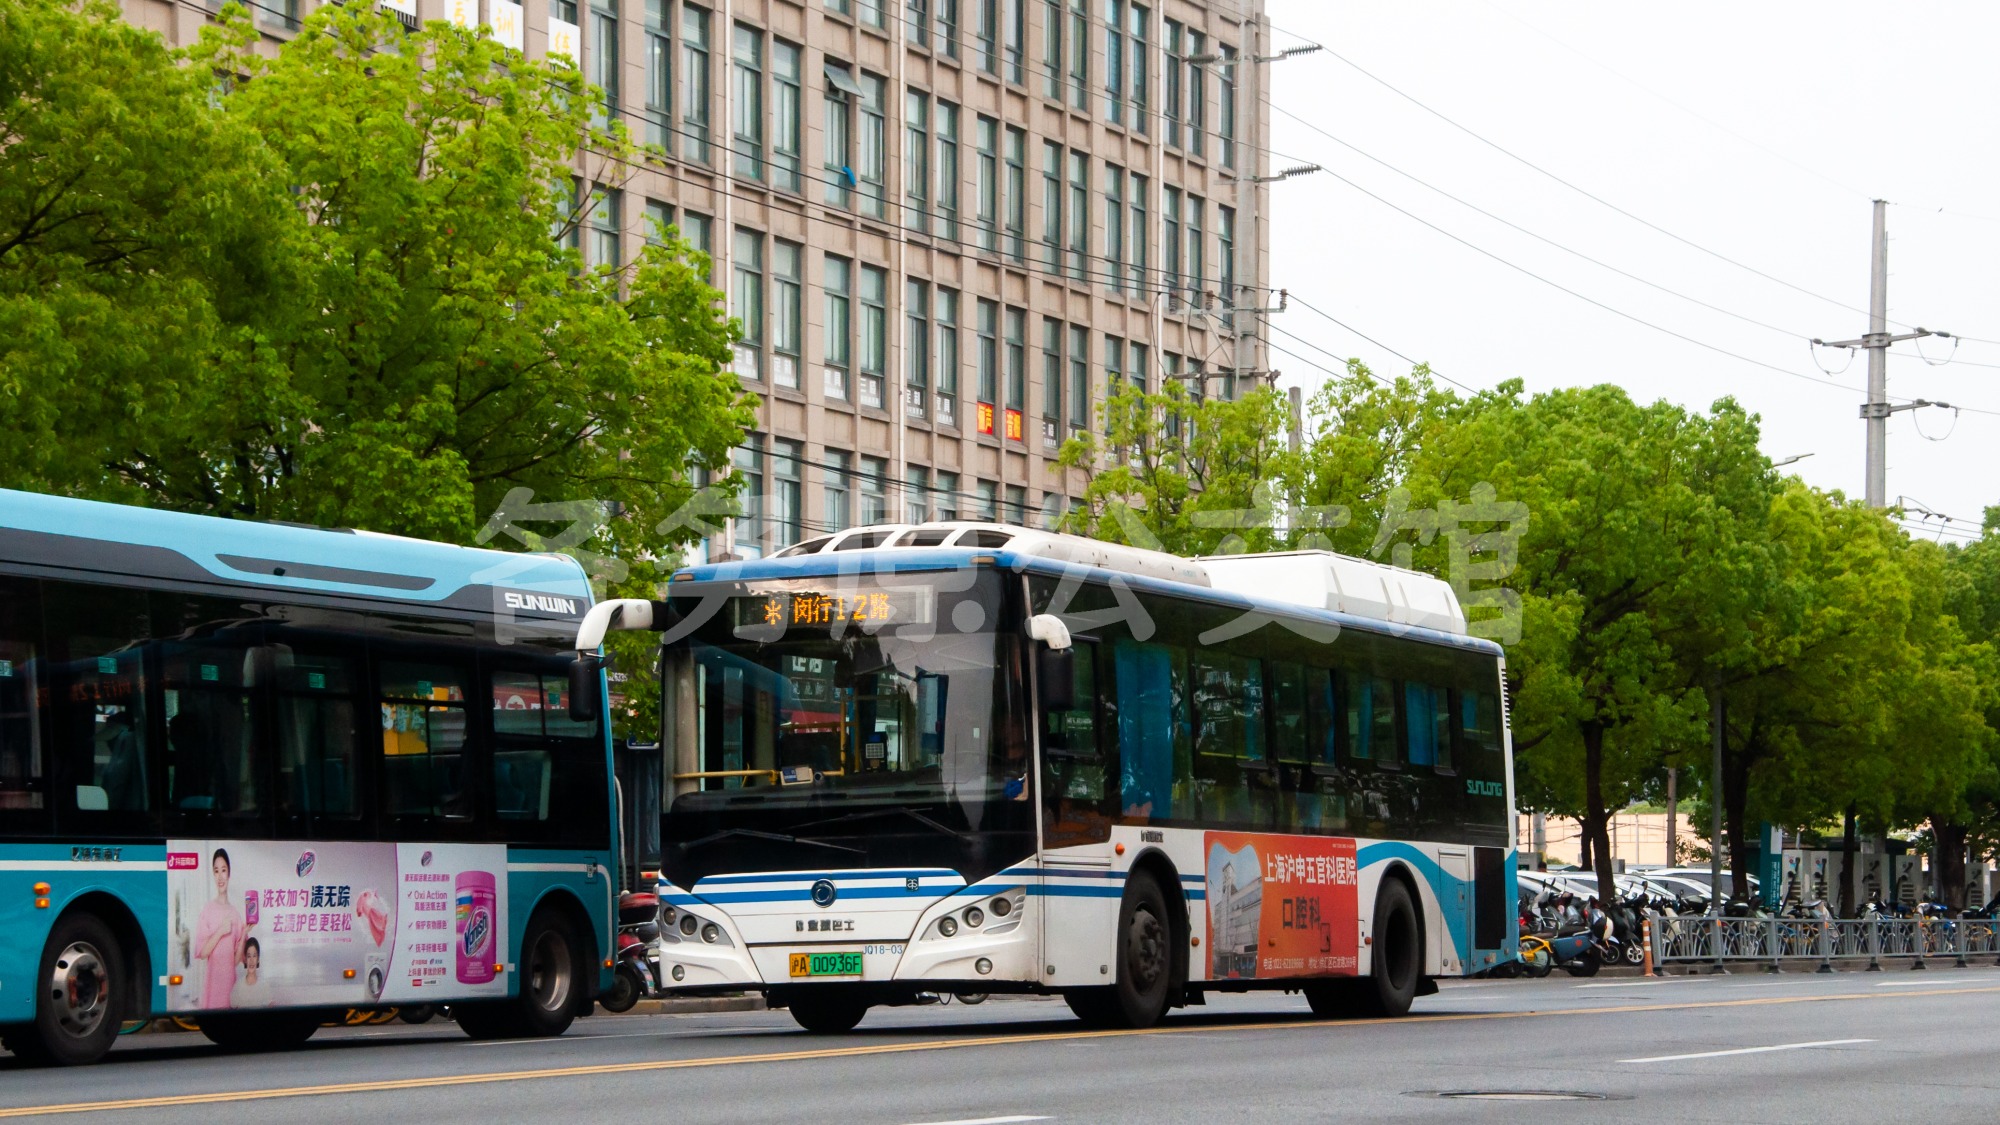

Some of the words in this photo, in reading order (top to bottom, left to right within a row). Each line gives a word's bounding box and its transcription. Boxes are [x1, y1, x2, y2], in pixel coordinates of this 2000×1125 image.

[504, 592, 576, 615] SUNWIN
[1466, 779, 1503, 797] SUNLONG
[1264, 853, 1357, 885] 上海沪申五官科医院
[262, 885, 351, 908] 洗衣加勺渍无踪
[414, 891, 426, 900] Oxi
[427, 891, 448, 900] Action
[272, 913, 352, 933] 去渍护色更轻松
[1282, 897, 1321, 929] 口腔科
[862, 945, 903, 955] JQ18-03
